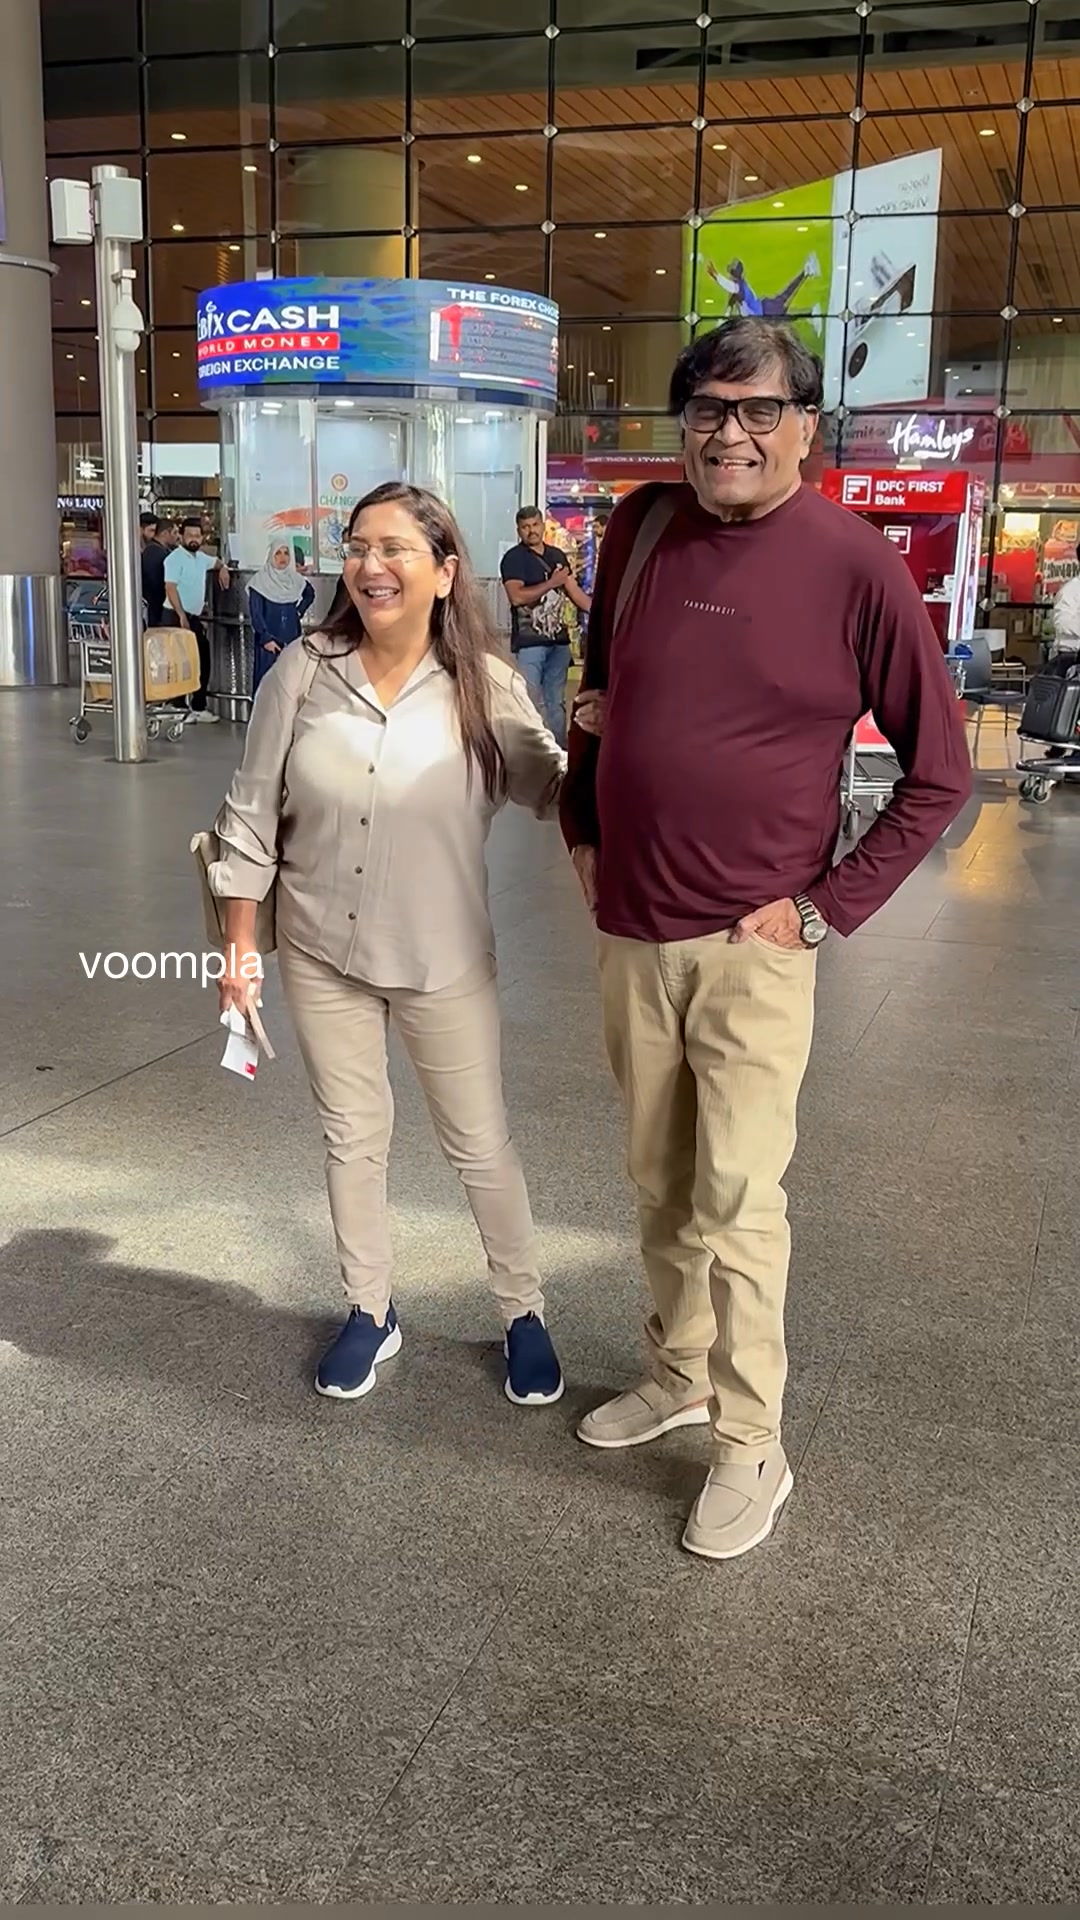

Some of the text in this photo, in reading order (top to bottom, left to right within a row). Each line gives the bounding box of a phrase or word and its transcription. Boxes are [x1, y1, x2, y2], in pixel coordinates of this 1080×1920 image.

[447, 287, 486, 302] THE
[490, 293, 537, 310] FOREX
[244, 336, 330, 349] MONEY
[234, 355, 340, 373] EXCHANGE
[887, 413, 975, 461] Hamleys
[875, 479, 945, 492] IDFC FIRST
[875, 494, 906, 506] Bank
